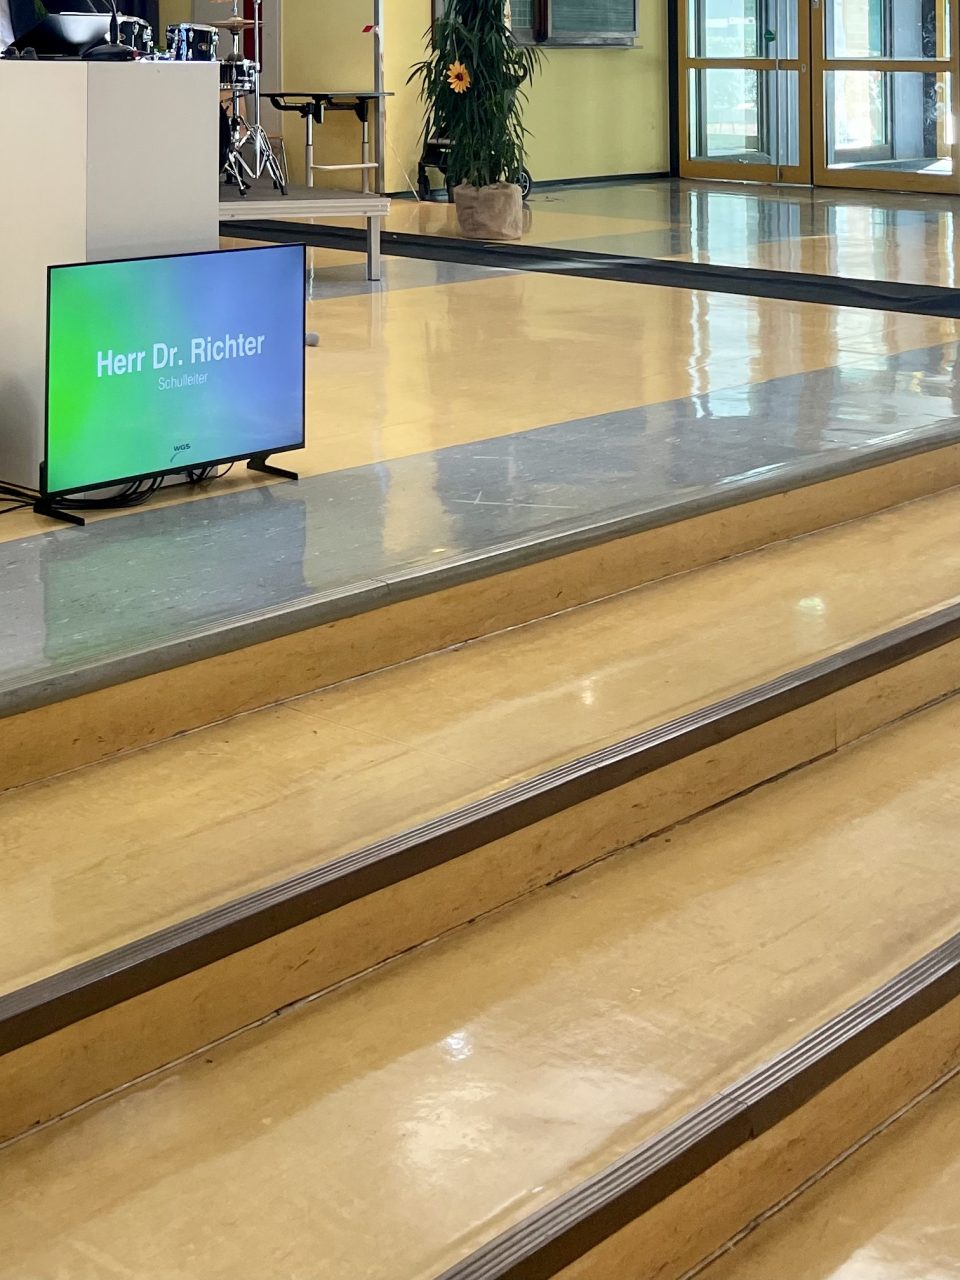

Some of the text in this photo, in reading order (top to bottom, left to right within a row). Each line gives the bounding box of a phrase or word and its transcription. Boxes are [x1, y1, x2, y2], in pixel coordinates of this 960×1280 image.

[97, 333, 265, 377] Herr Dr. Richter
[158, 373, 208, 391] Schulleiter
[173, 443, 191, 452] WGS
